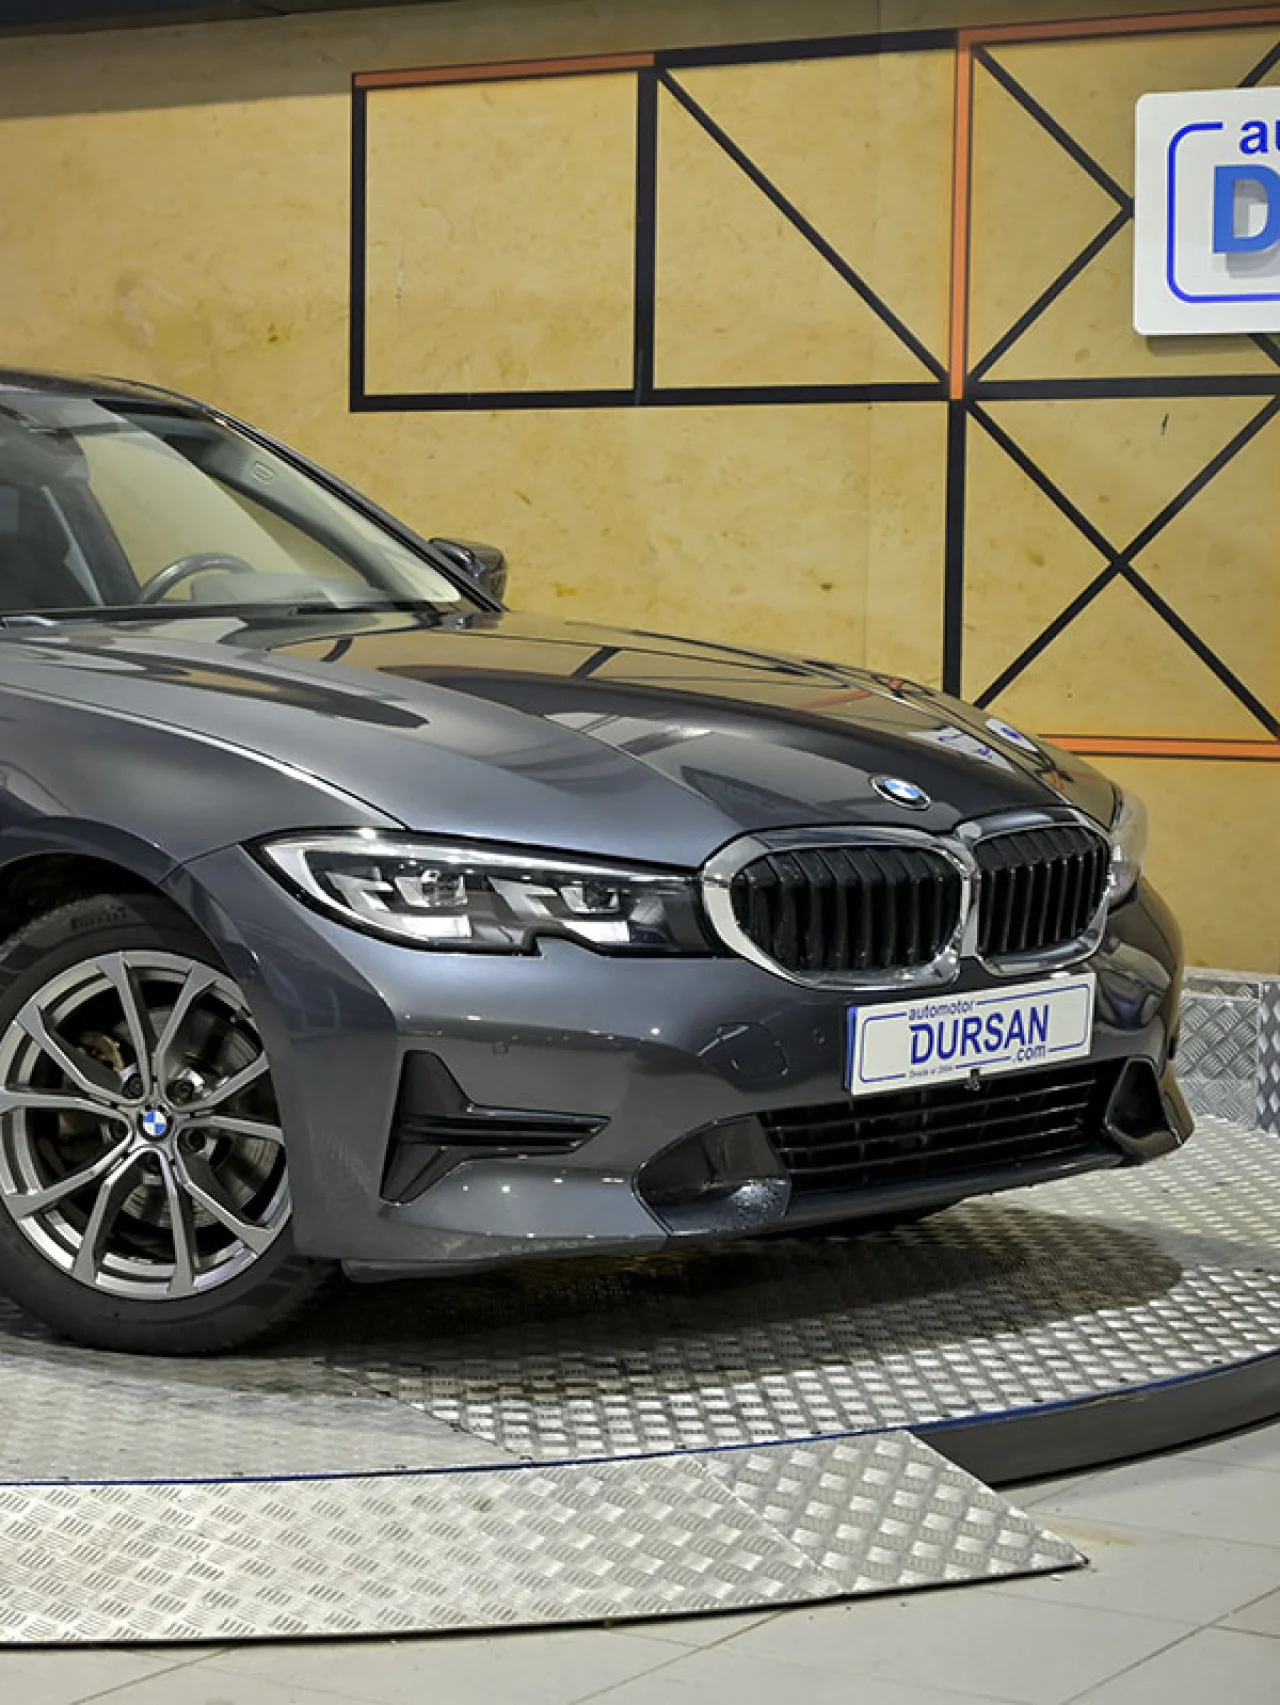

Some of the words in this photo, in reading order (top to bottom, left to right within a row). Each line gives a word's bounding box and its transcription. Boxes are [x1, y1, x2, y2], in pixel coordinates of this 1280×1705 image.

[1239, 119, 1280, 155] a
[908, 999, 976, 1021] automotor
[908, 1004, 1050, 1066] DURSAN
